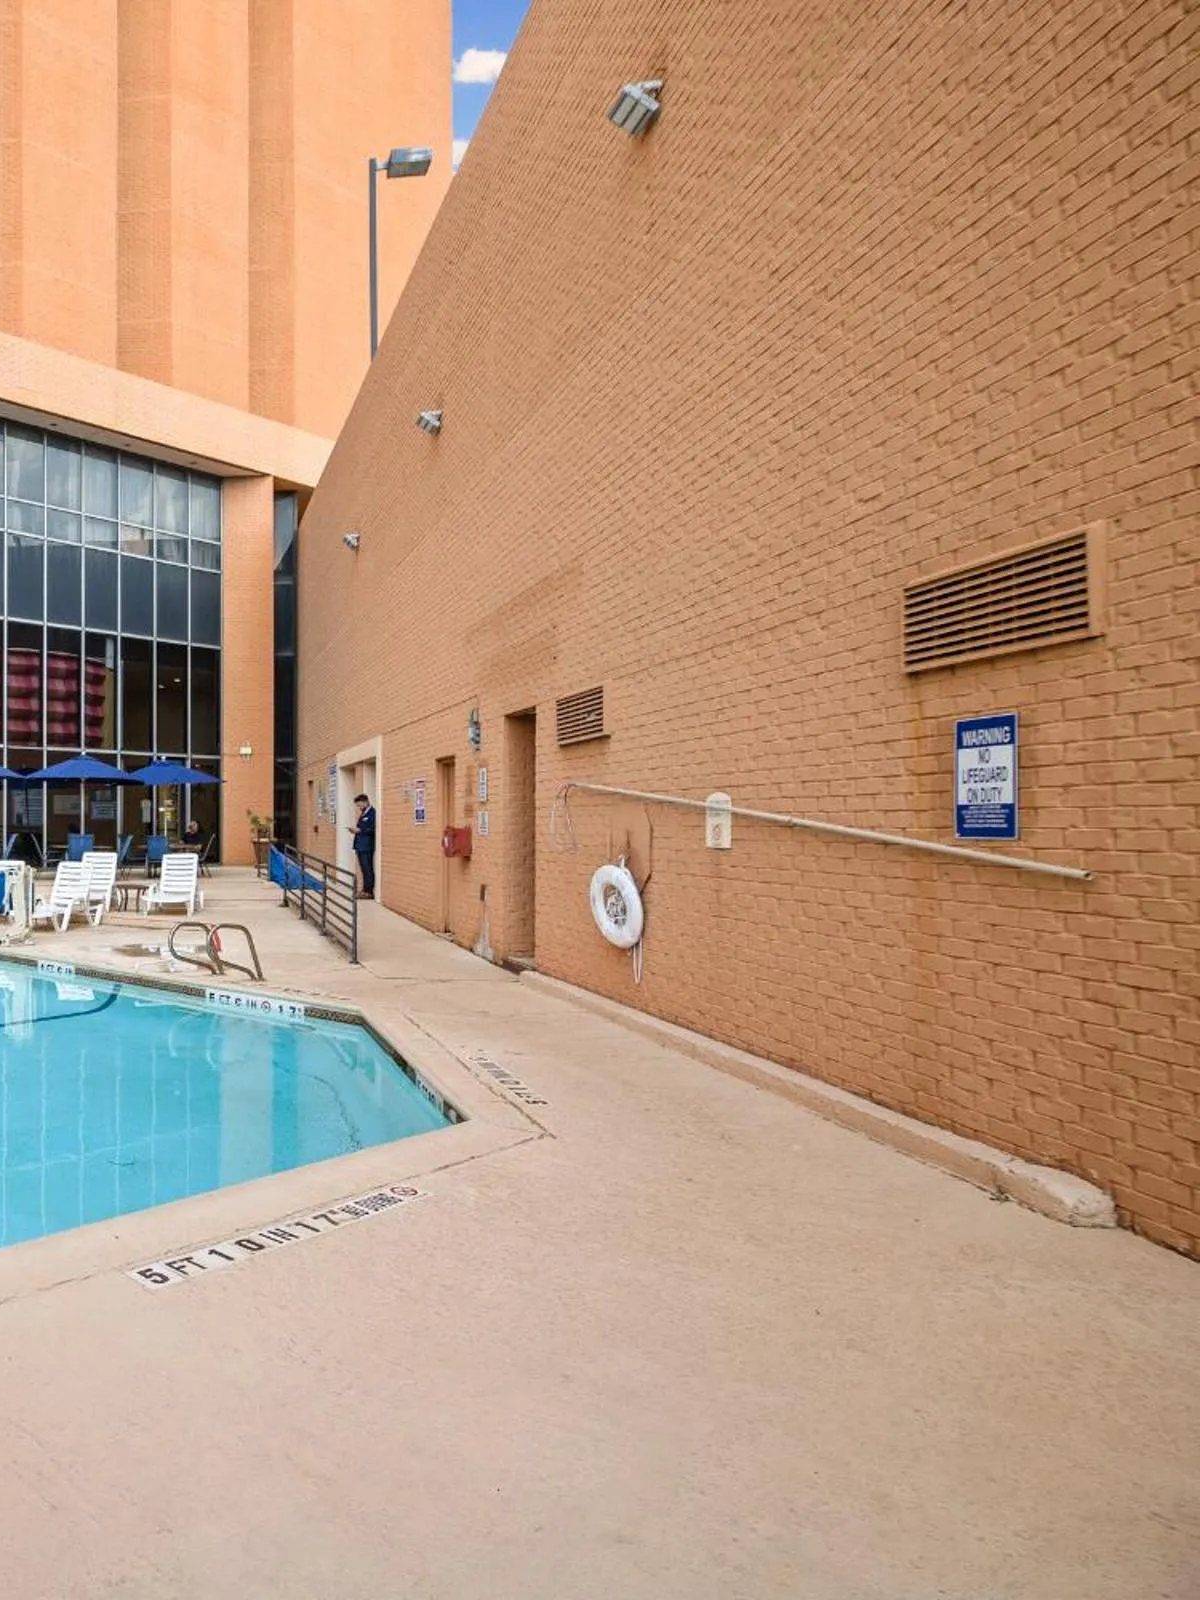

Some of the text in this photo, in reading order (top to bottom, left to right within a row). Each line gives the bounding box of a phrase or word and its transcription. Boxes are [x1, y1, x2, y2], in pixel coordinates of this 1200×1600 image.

[962, 726, 1011, 746] WARNING
[978, 748, 991, 763] NO
[962, 766, 1009, 784] LIFEGUARD
[967, 786, 1004, 803] ON DUTY
